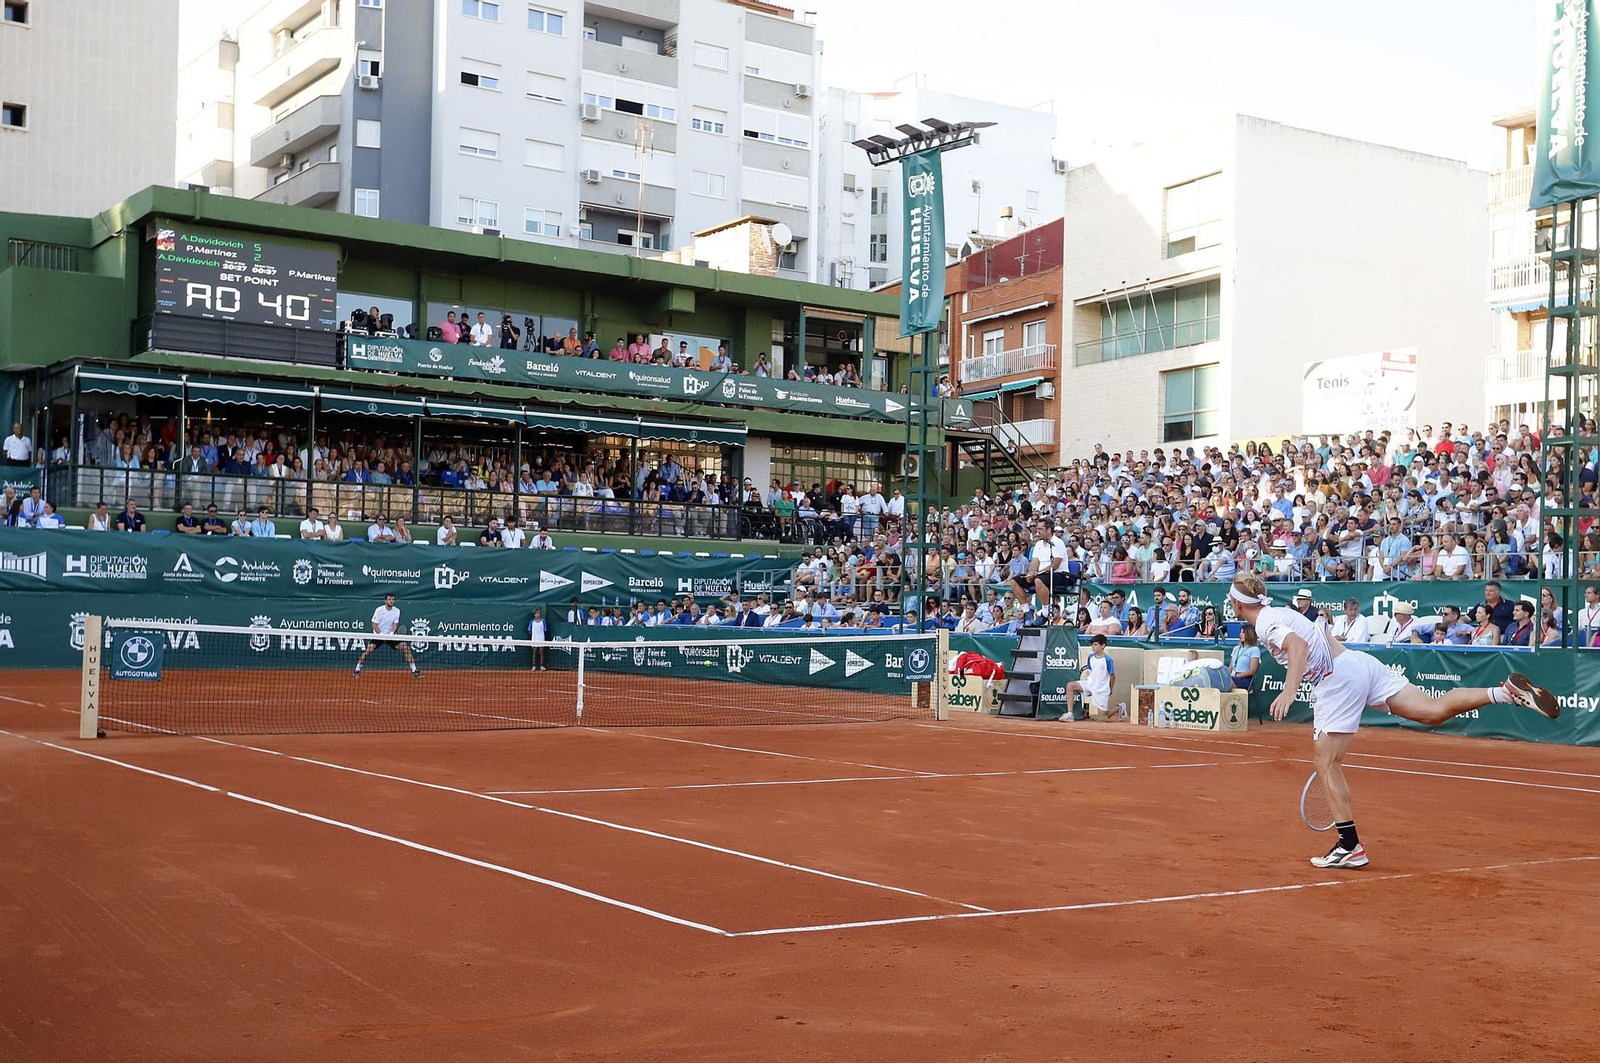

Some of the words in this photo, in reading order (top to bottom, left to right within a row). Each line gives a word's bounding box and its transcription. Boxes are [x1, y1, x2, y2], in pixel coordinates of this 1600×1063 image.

[180, 234, 244, 249] A.Davidovich
[922, 204, 933, 282] Ayuntamiento
[186, 245, 238, 258] P.Martínez
[254, 253, 262, 262] 2
[908, 207, 922, 305] HUELVA
[157, 253, 220, 267] A.Davidovich
[219, 273, 242, 283] SET
[243, 276, 280, 287] POINT
[921, 285, 932, 298] de
[258, 291, 310, 321] 40
[526, 360, 559, 373] Barceló
[574, 369, 617, 379] VITALDENT
[1316, 375, 1350, 389] Tenis
[90, 554, 148, 565] DIPUTACIÓN
[240, 560, 280, 572] Andalucía
[90, 564, 103, 572] DE
[107, 564, 147, 573] HUELVA
[324, 578, 354, 586] Frontera
[478, 576, 529, 584] VITALDENT
[628, 576, 664, 588] Barceló
[693, 577, 733, 586] DIPUTACIÓN
[279, 618, 350, 631] Ayuntamiento
[351, 619, 364, 630] de
[437, 620, 500, 633] Ayuntamiento
[501, 621, 514, 632] de
[280, 633, 366, 651] HUELVA
[1046, 654, 1078, 670] Seabery
[88, 645, 97, 710] HUELVA
[115, 670, 158, 678] AUTOGOTRAN
[1416, 671, 1462, 682] Ayuntamiento
[1555, 693, 1600, 713] nday
[1164, 701, 1219, 730] Seabery
